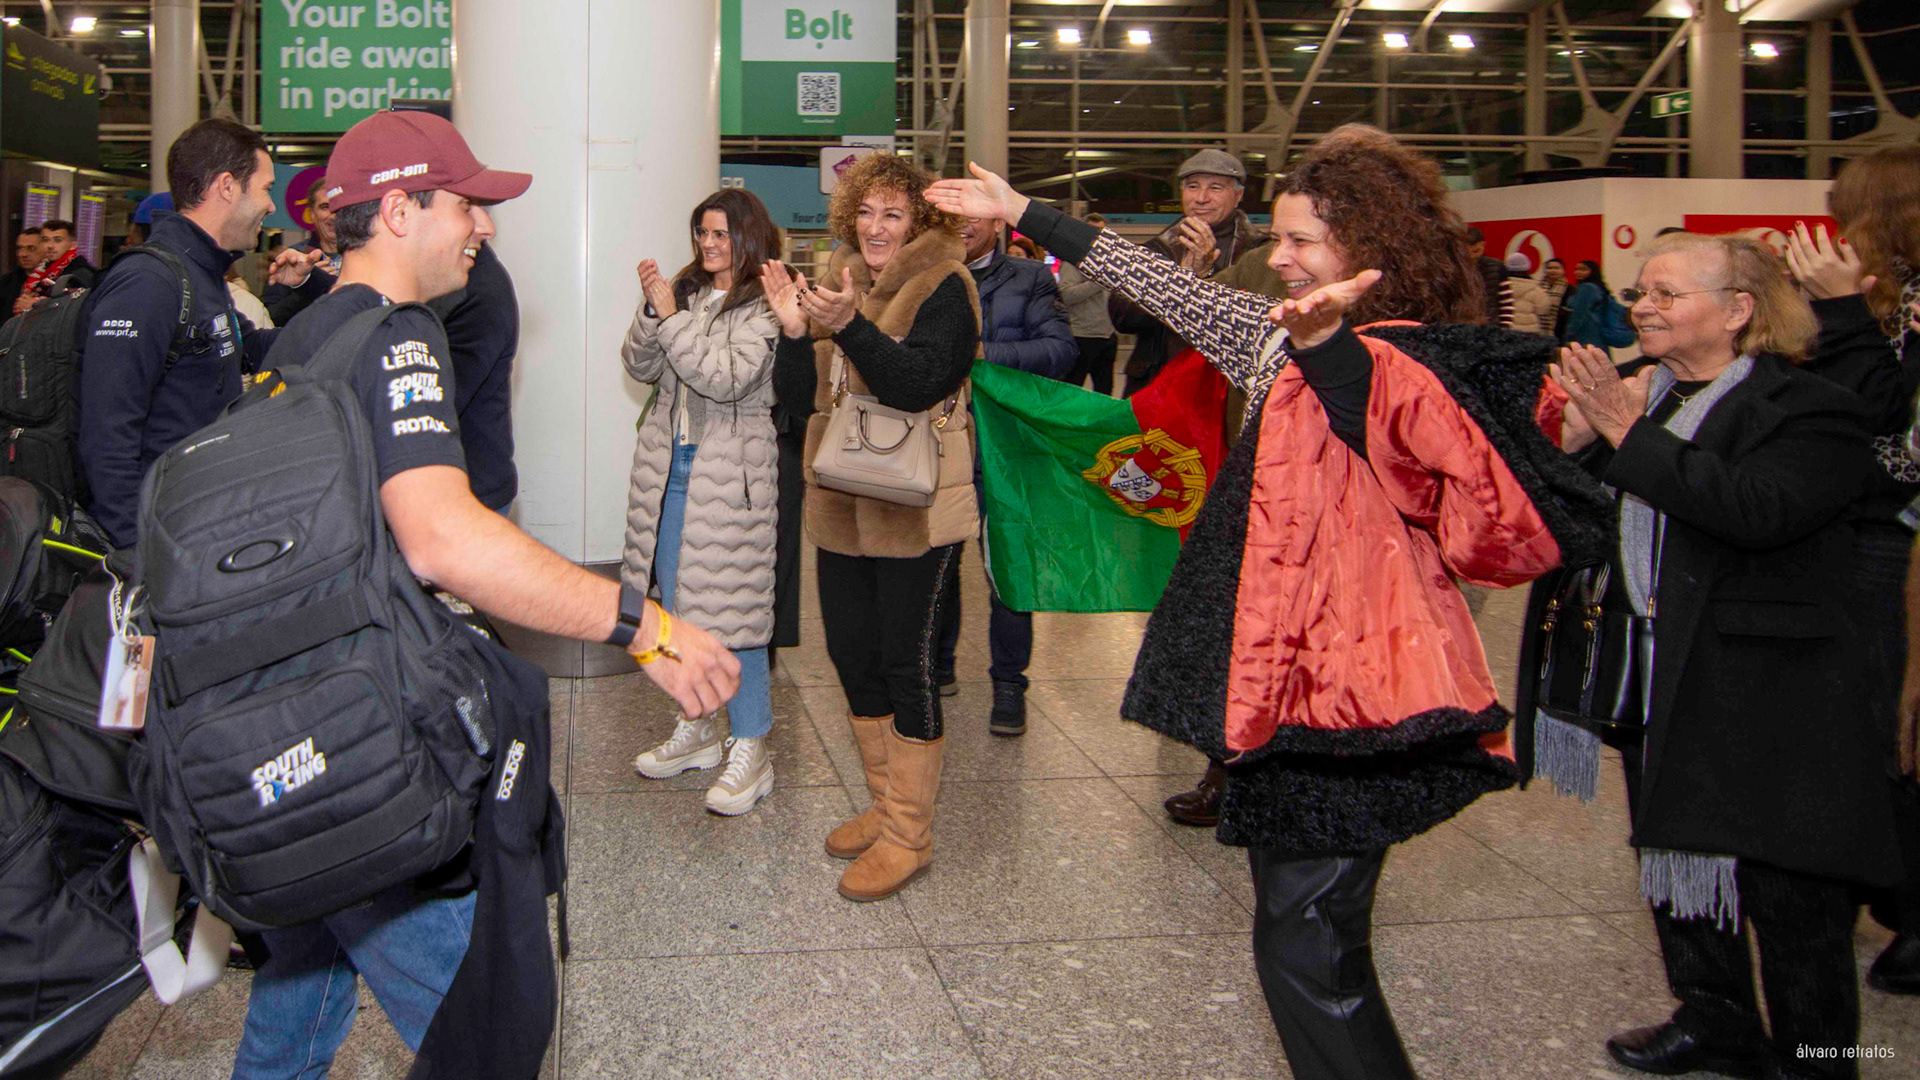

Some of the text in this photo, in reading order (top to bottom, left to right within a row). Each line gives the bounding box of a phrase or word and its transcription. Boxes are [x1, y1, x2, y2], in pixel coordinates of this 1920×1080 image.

[284, 0, 450, 28] Your Bolt
[785, 8, 853, 49] Bolt
[280, 36, 450, 69] ride awai
[280, 77, 452, 117] in parkin
[370, 162, 429, 185] can-am
[94, 327, 139, 338] www.prf.pt
[381, 350, 441, 371] LEIRIA
[390, 340, 430, 356] VISITE
[387, 371, 439, 398] SOUTH
[392, 415, 451, 437] ROTAX
[250, 736, 315, 792] SOUTH
[499, 741, 526, 801] sparco
